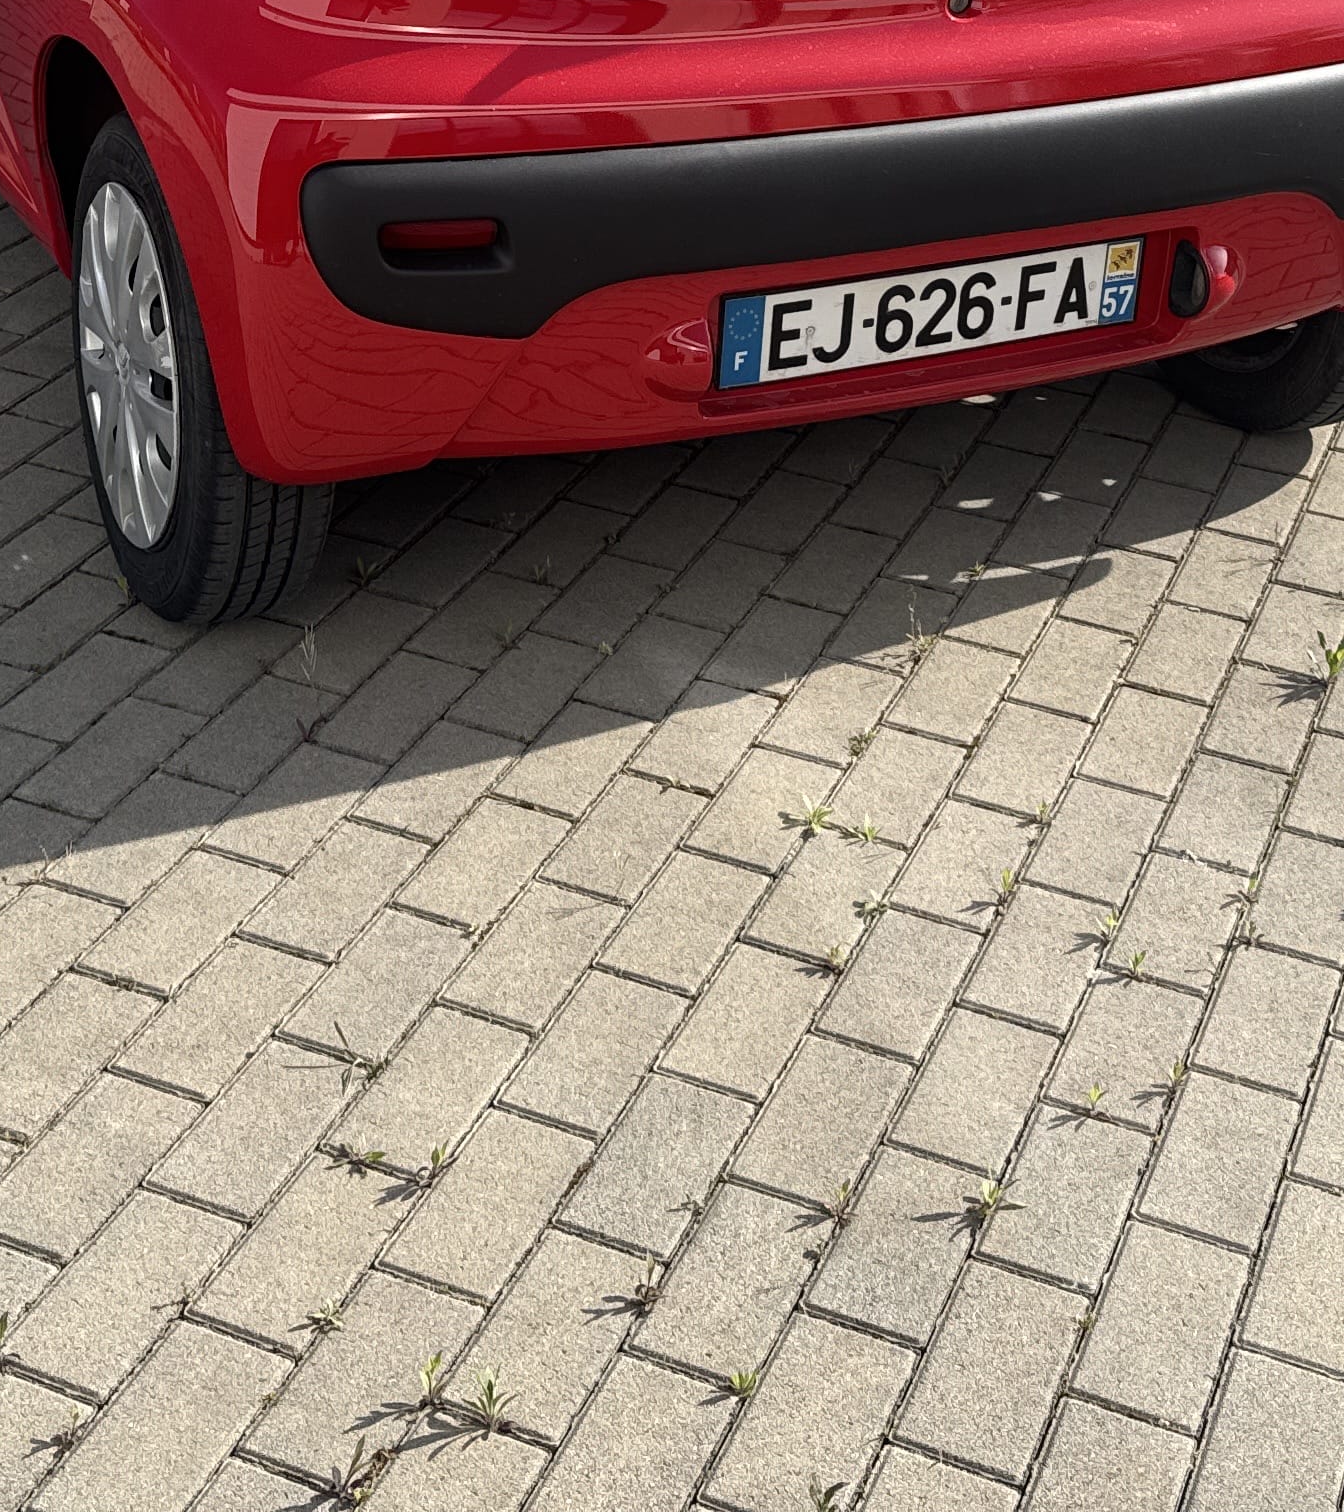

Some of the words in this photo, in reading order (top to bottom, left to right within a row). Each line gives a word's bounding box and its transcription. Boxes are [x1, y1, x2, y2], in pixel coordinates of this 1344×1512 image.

[734, 351, 748, 371] F
[766, 256, 1089, 371] EJ-626-FA
[1101, 284, 1135, 317] 57
